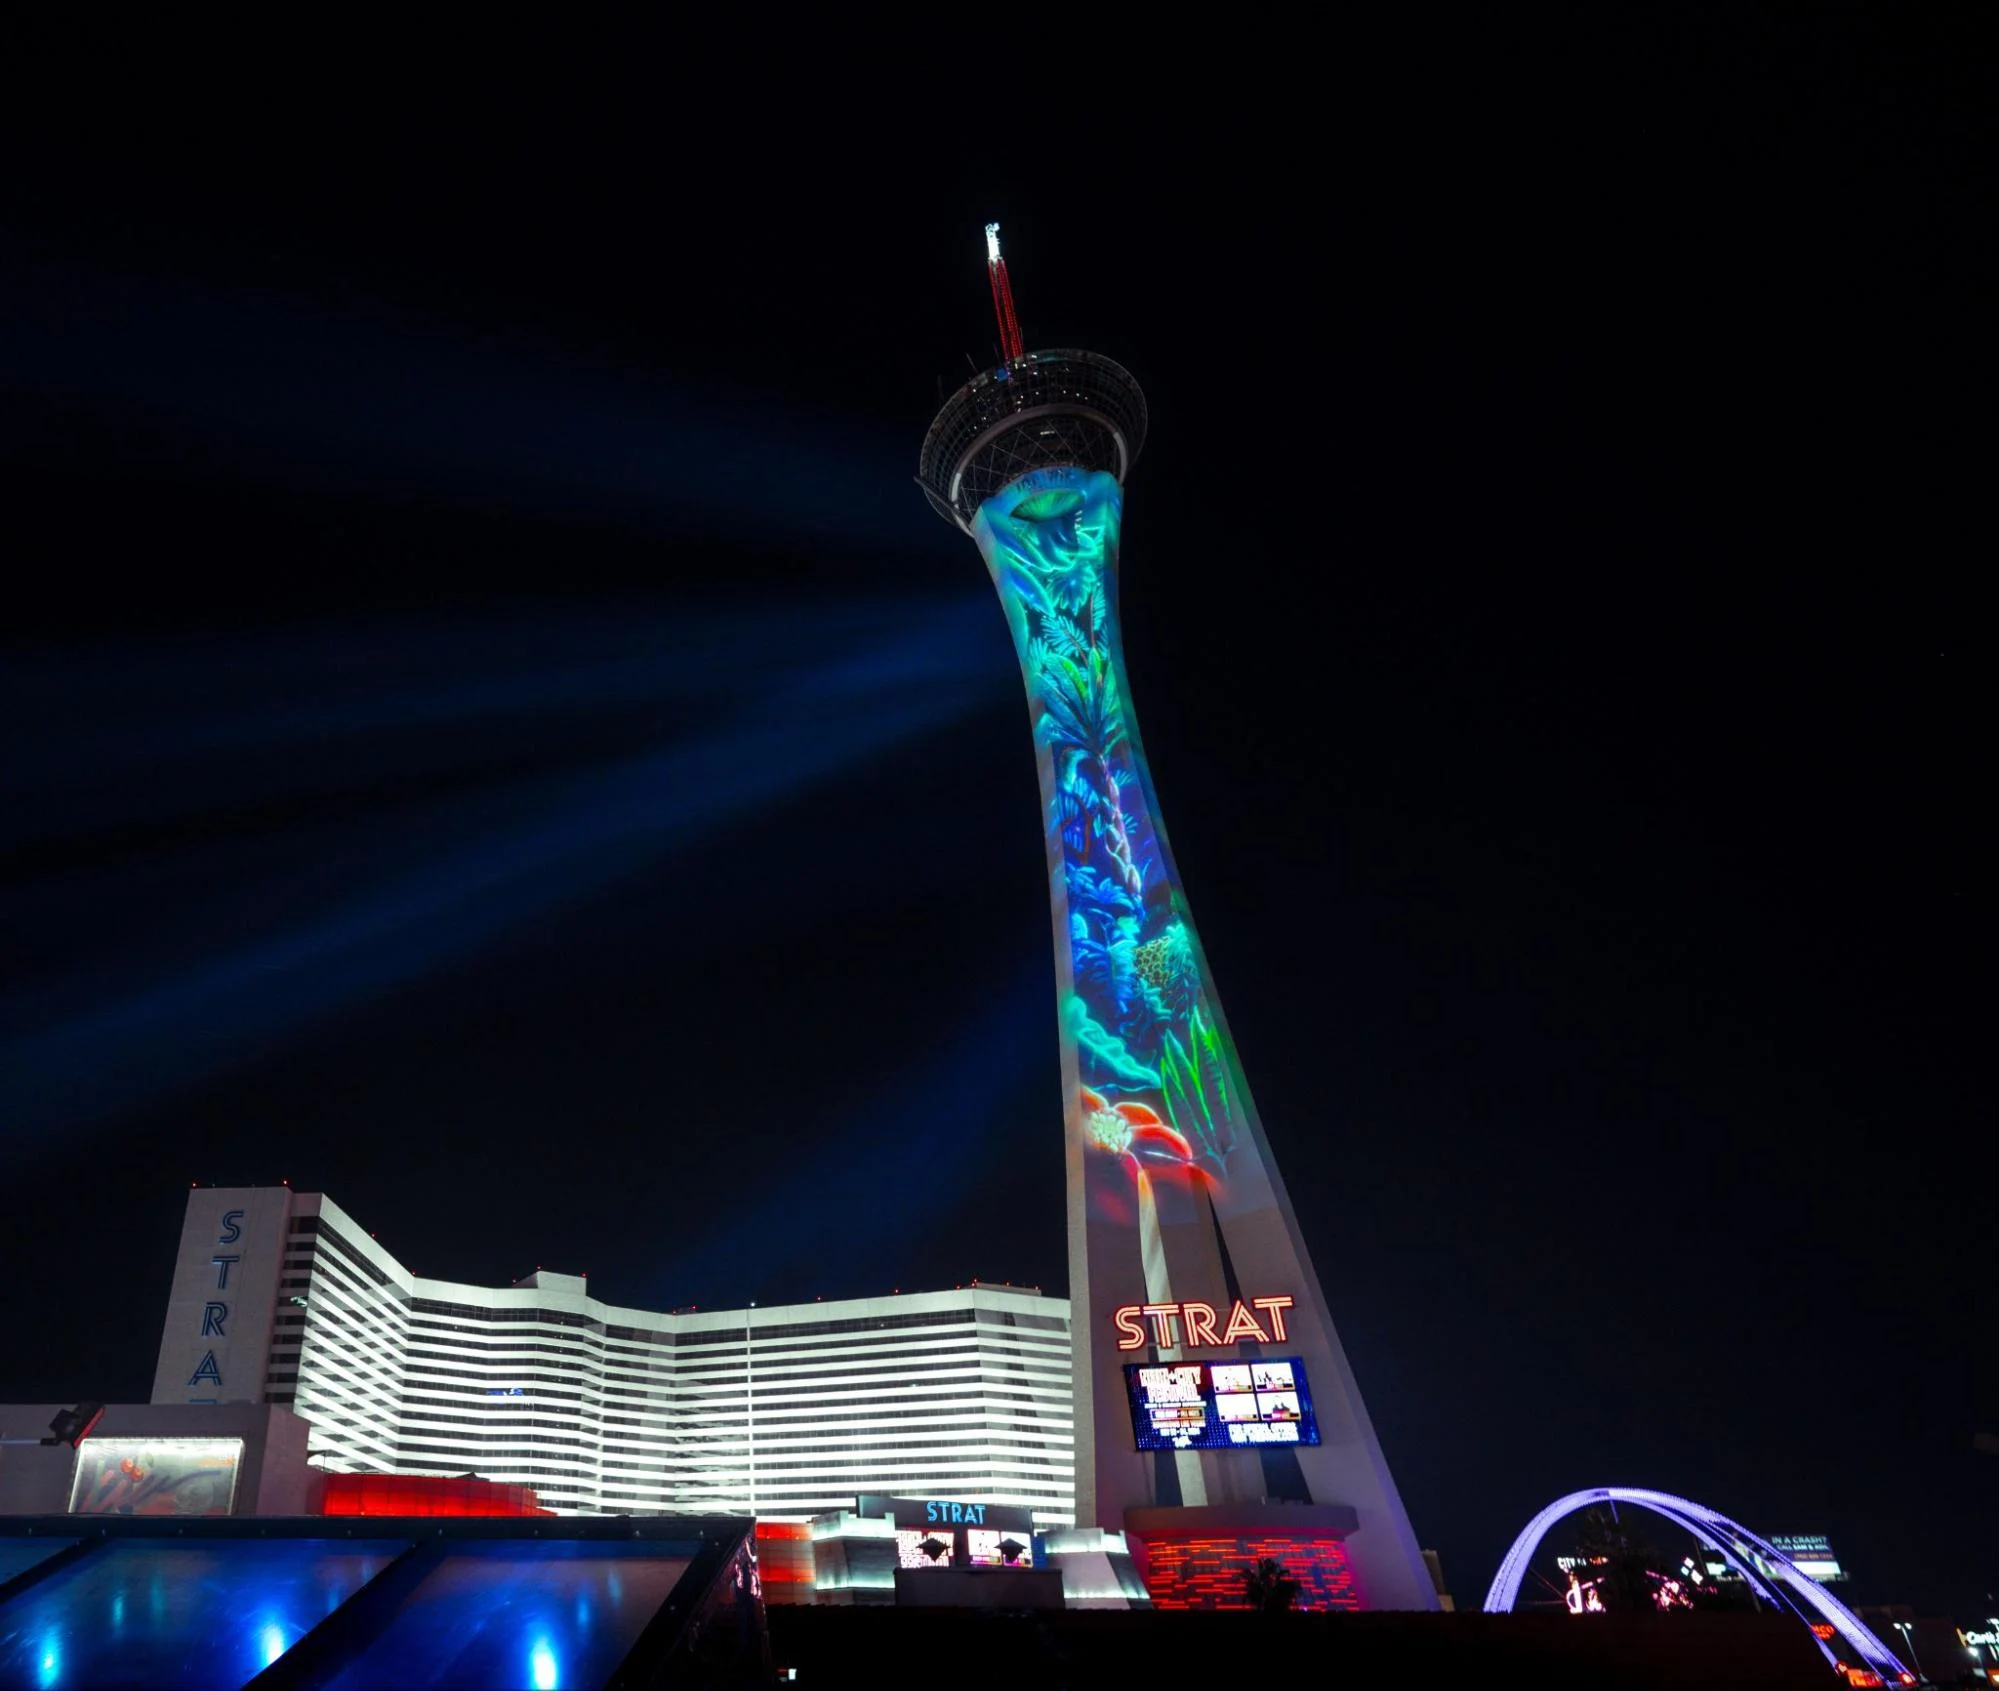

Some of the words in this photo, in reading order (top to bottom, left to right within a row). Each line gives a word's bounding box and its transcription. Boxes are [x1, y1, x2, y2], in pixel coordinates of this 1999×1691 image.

[187, 1209, 245, 1405] STRA
[1114, 1296, 1294, 1350] STRAT
[926, 1501, 986, 1524] STRAT
[1771, 1536, 1782, 1544] IN
